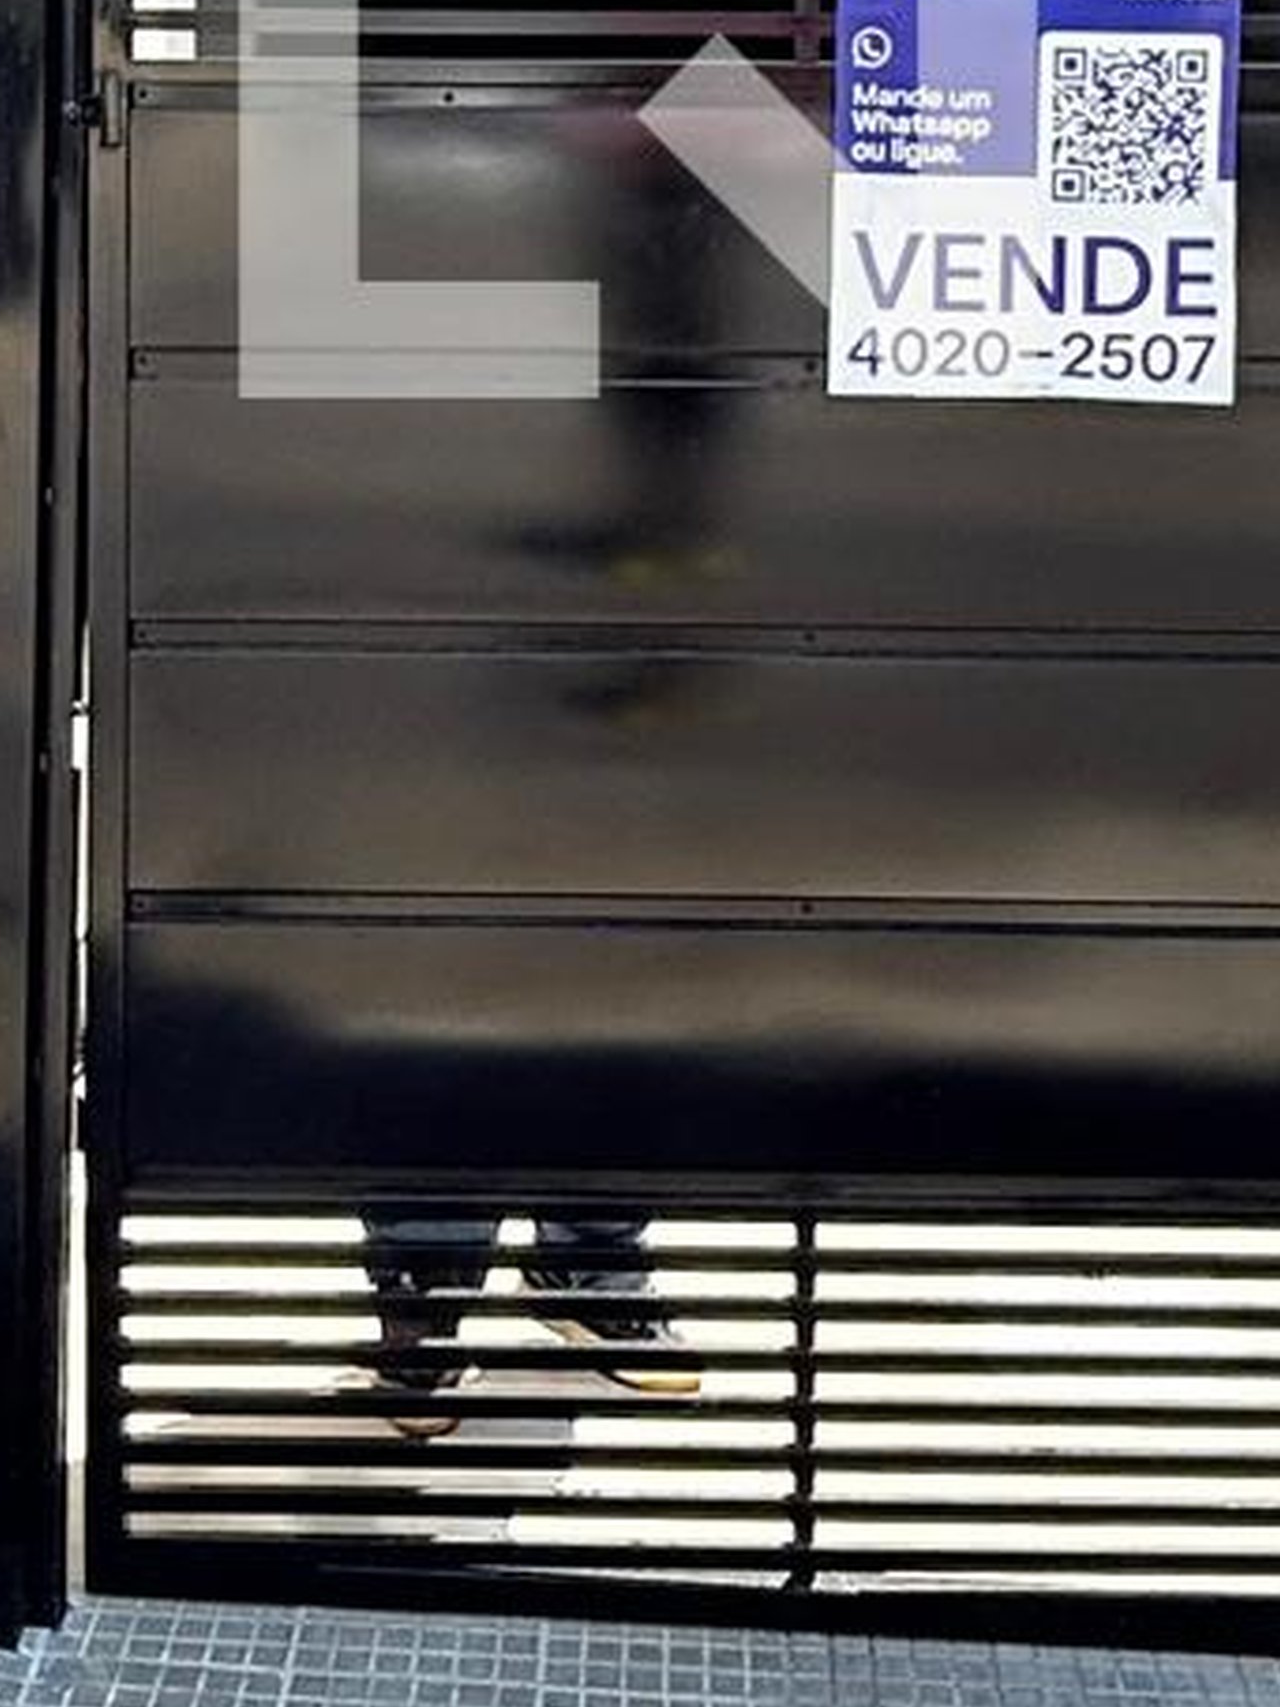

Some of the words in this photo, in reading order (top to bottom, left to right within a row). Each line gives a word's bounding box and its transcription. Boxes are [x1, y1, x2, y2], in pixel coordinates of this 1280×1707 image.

[852, 82, 944, 109] Mande
[949, 90, 992, 109] um
[851, 141, 886, 162] ou
[890, 137, 964, 168] ligue.
[852, 230, 1219, 318] VENDE
[847, 327, 1216, 385] 4020-2507
